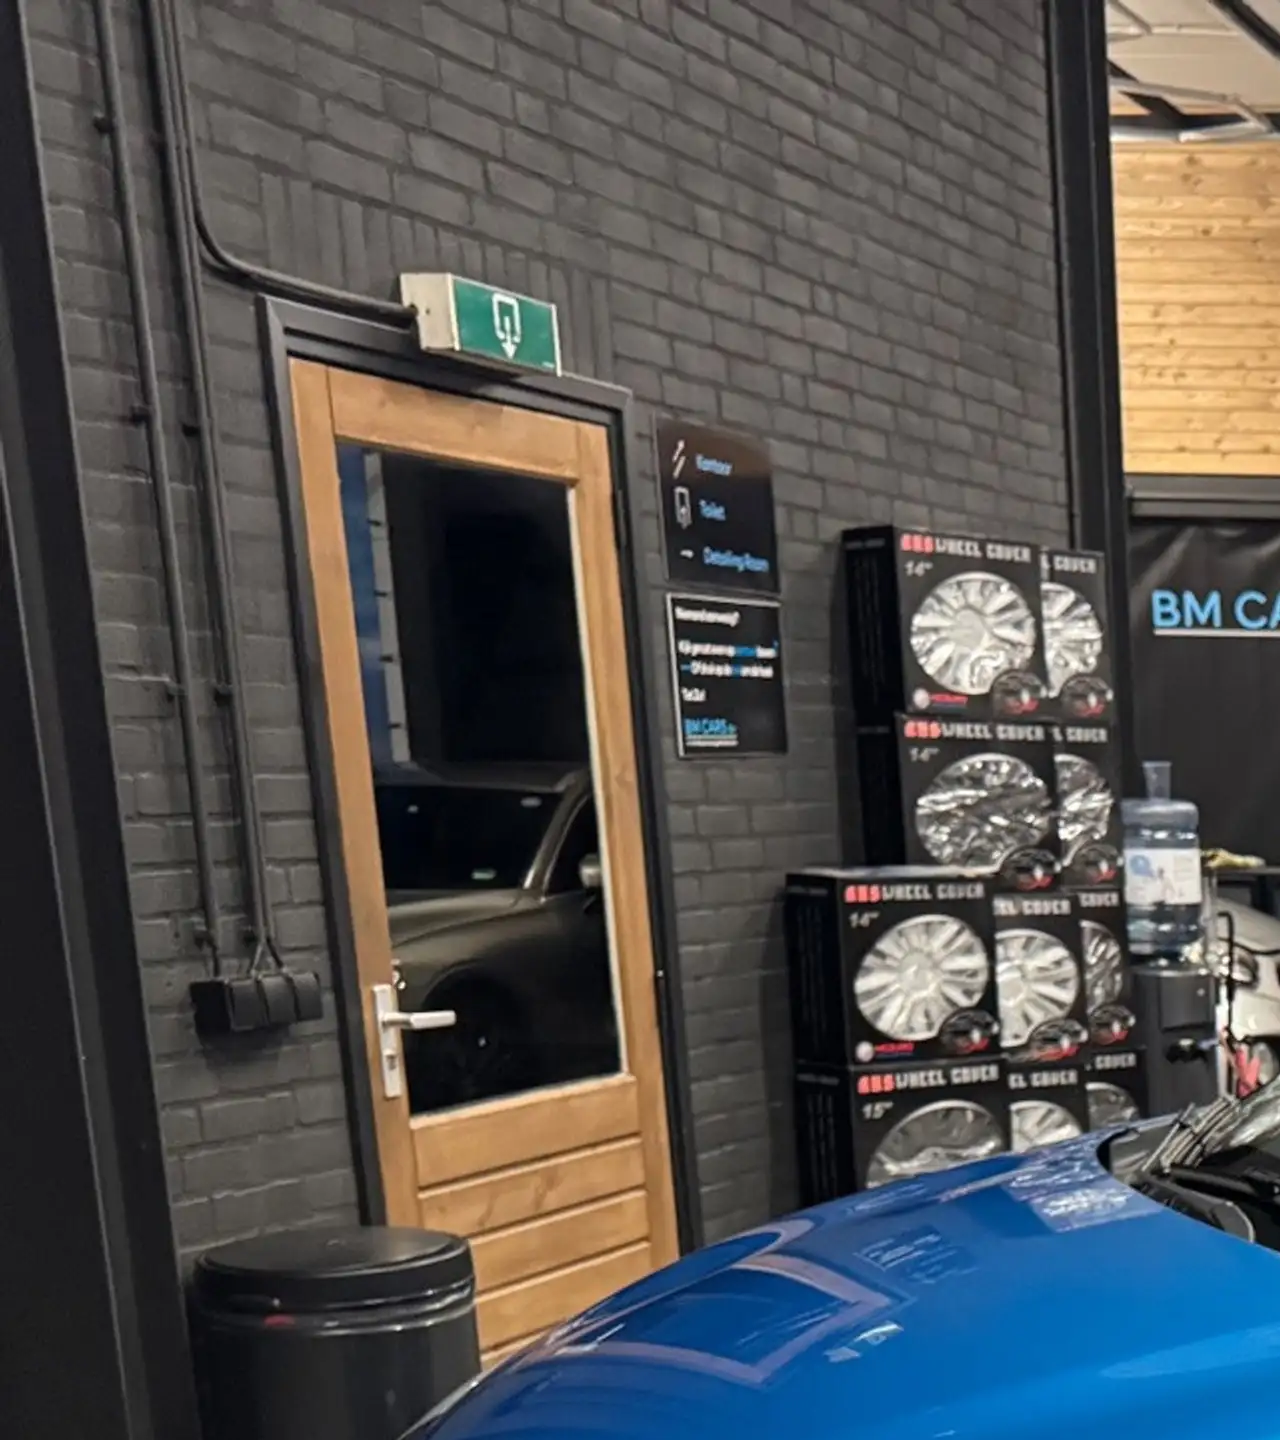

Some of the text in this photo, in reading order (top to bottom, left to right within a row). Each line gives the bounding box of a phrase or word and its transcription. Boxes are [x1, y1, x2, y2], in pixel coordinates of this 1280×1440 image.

[935, 536, 982, 558] WHEEL
[986, 543, 1031, 562] COVER
[1053, 555, 1097, 573] COVER
[1151, 589, 1222, 628] BM
[941, 721, 992, 739] WHEEL
[997, 723, 1044, 740] COVER
[1066, 727, 1107, 743] COVER
[882, 884, 932, 901] WHEEL
[937, 883, 985, 900] COVER
[1077, 892, 1119, 908] COVER
[1022, 899, 1071, 916] COVER
[1095, 1054, 1136, 1070] COVER
[894, 1069, 946, 1089] WHEEL
[951, 1064, 999, 1085] COVER
[1031, 1070, 1078, 1088] COVER
